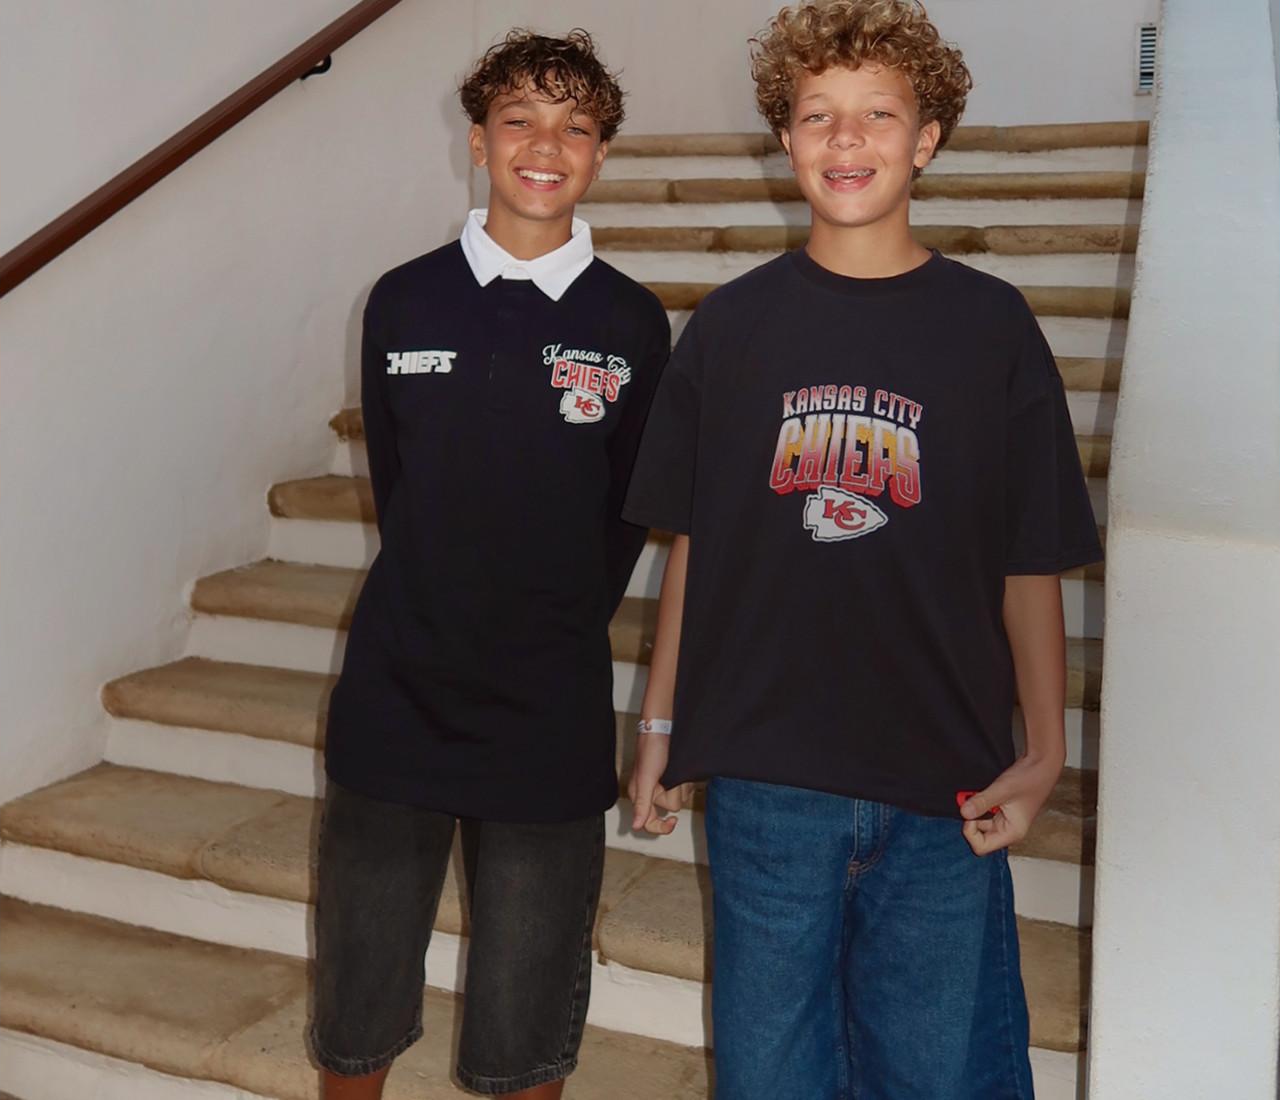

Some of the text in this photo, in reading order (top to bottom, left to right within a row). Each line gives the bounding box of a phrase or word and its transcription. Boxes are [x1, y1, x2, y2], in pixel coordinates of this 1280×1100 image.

[542, 343, 632, 386] Kansas City
[551, 359, 620, 402] CHIEFS
[782, 384, 923, 429] KANSAS CITY
[769, 413, 923, 509] CHIEFS
[822, 498, 867, 531] KC
